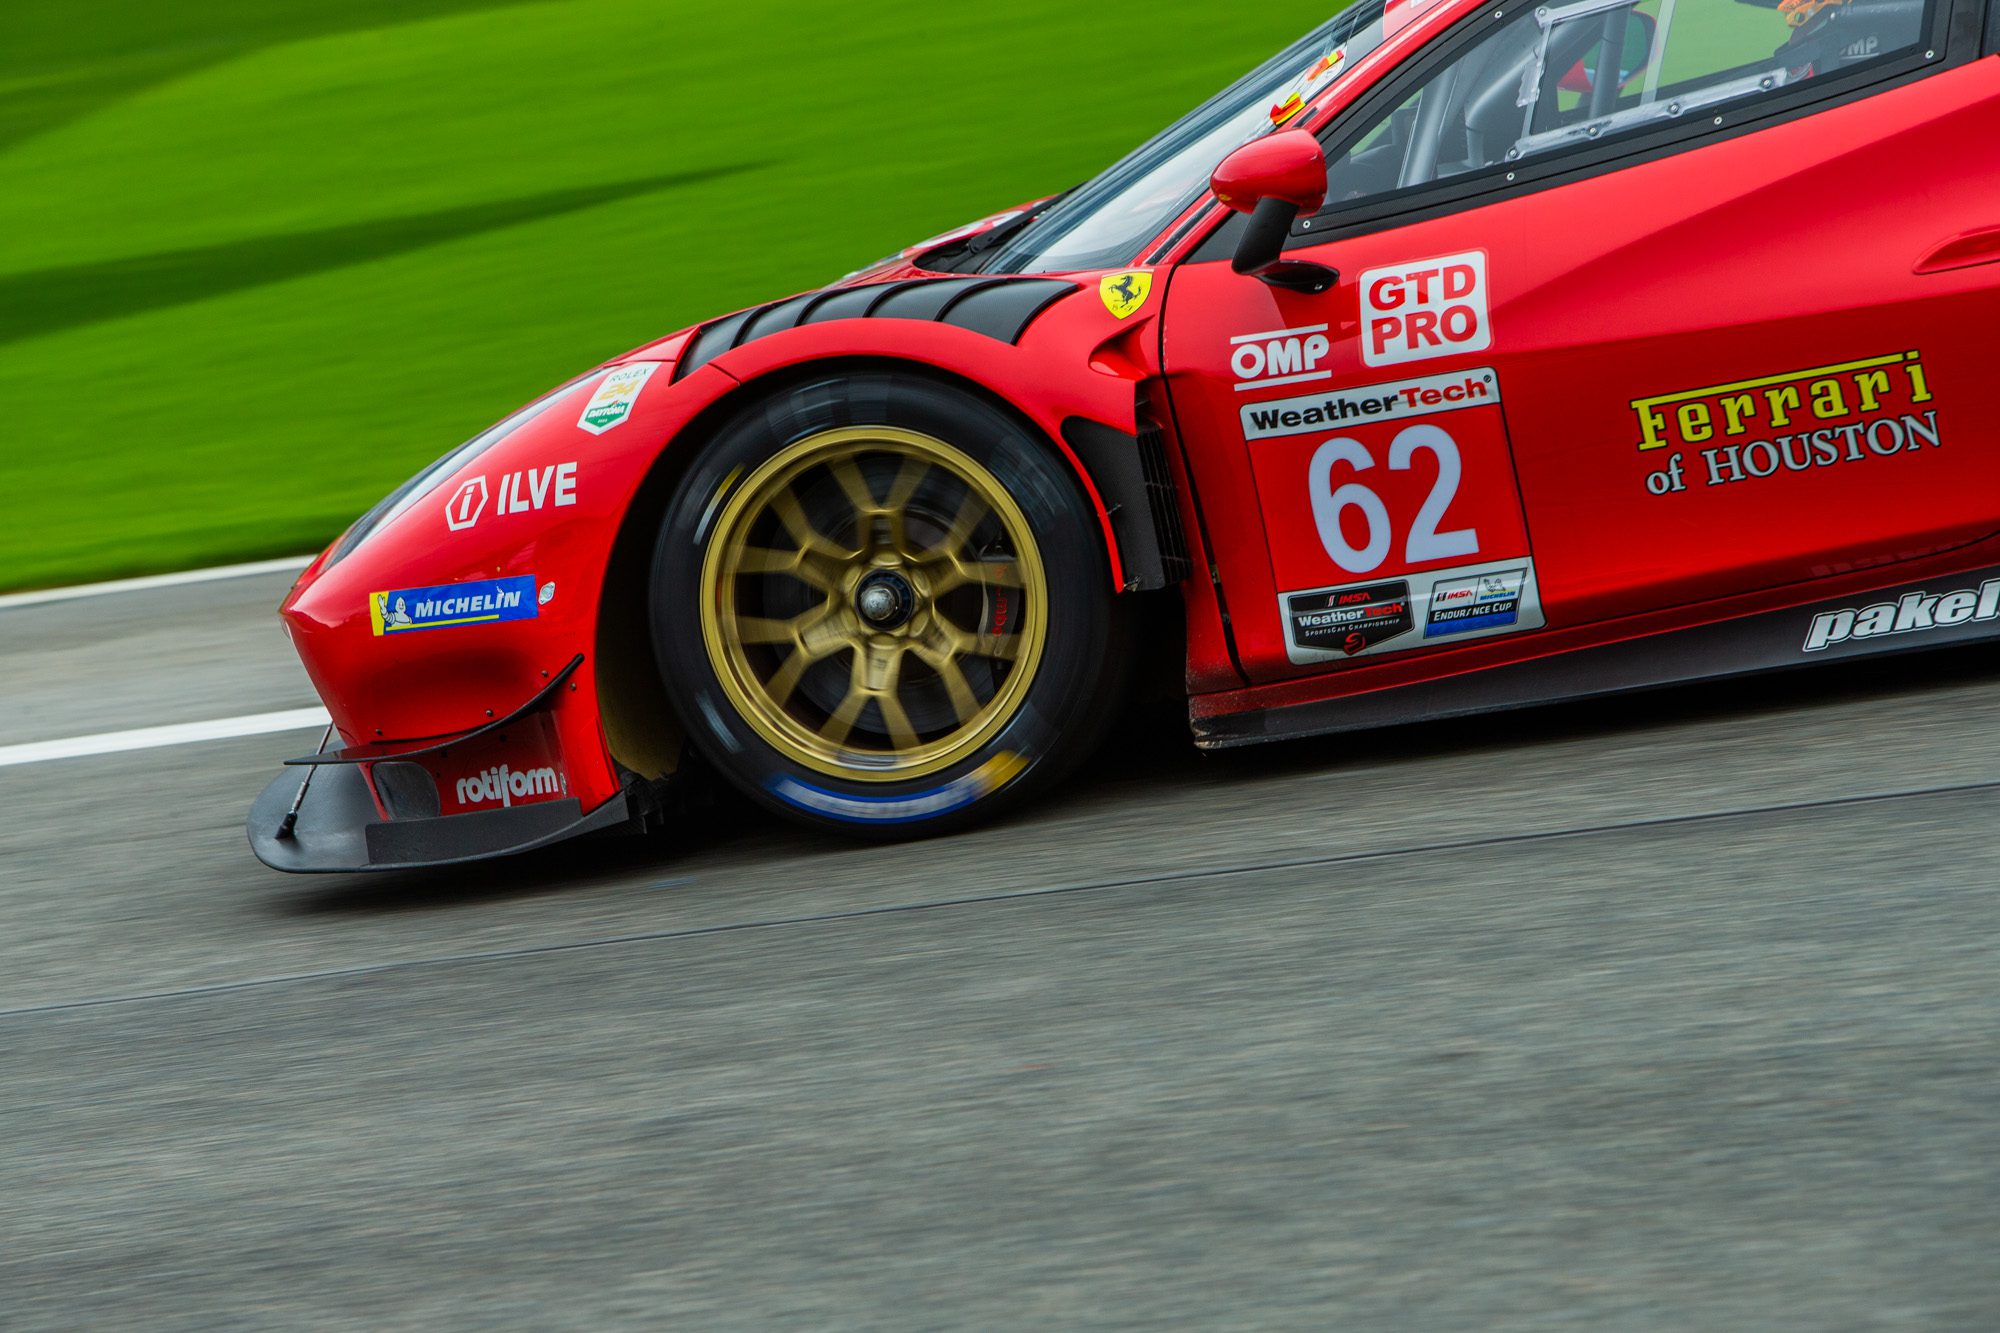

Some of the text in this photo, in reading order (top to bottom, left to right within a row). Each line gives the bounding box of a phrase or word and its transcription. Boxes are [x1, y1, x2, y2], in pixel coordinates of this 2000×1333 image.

[1839, 35, 1879, 56] MP
[1369, 264, 1476, 311] GTD
[1371, 305, 1478, 355] PRO
[1231, 334, 1329, 379] OMP
[588, 405, 625, 419] DAYTONA
[599, 379, 641, 401] 24
[1630, 350, 1933, 451] Ferrari
[1645, 411, 1941, 496] of HOUSTON
[497, 462, 578, 516] ILVE
[1307, 424, 1480, 574] 62
[415, 591, 521, 618] MICHELIN
[1338, 592, 1372, 605] IMSA
[1446, 589, 1473, 600] IMSA
[1803, 578, 2000, 653] pakel
[456, 764, 559, 808] rotiform
